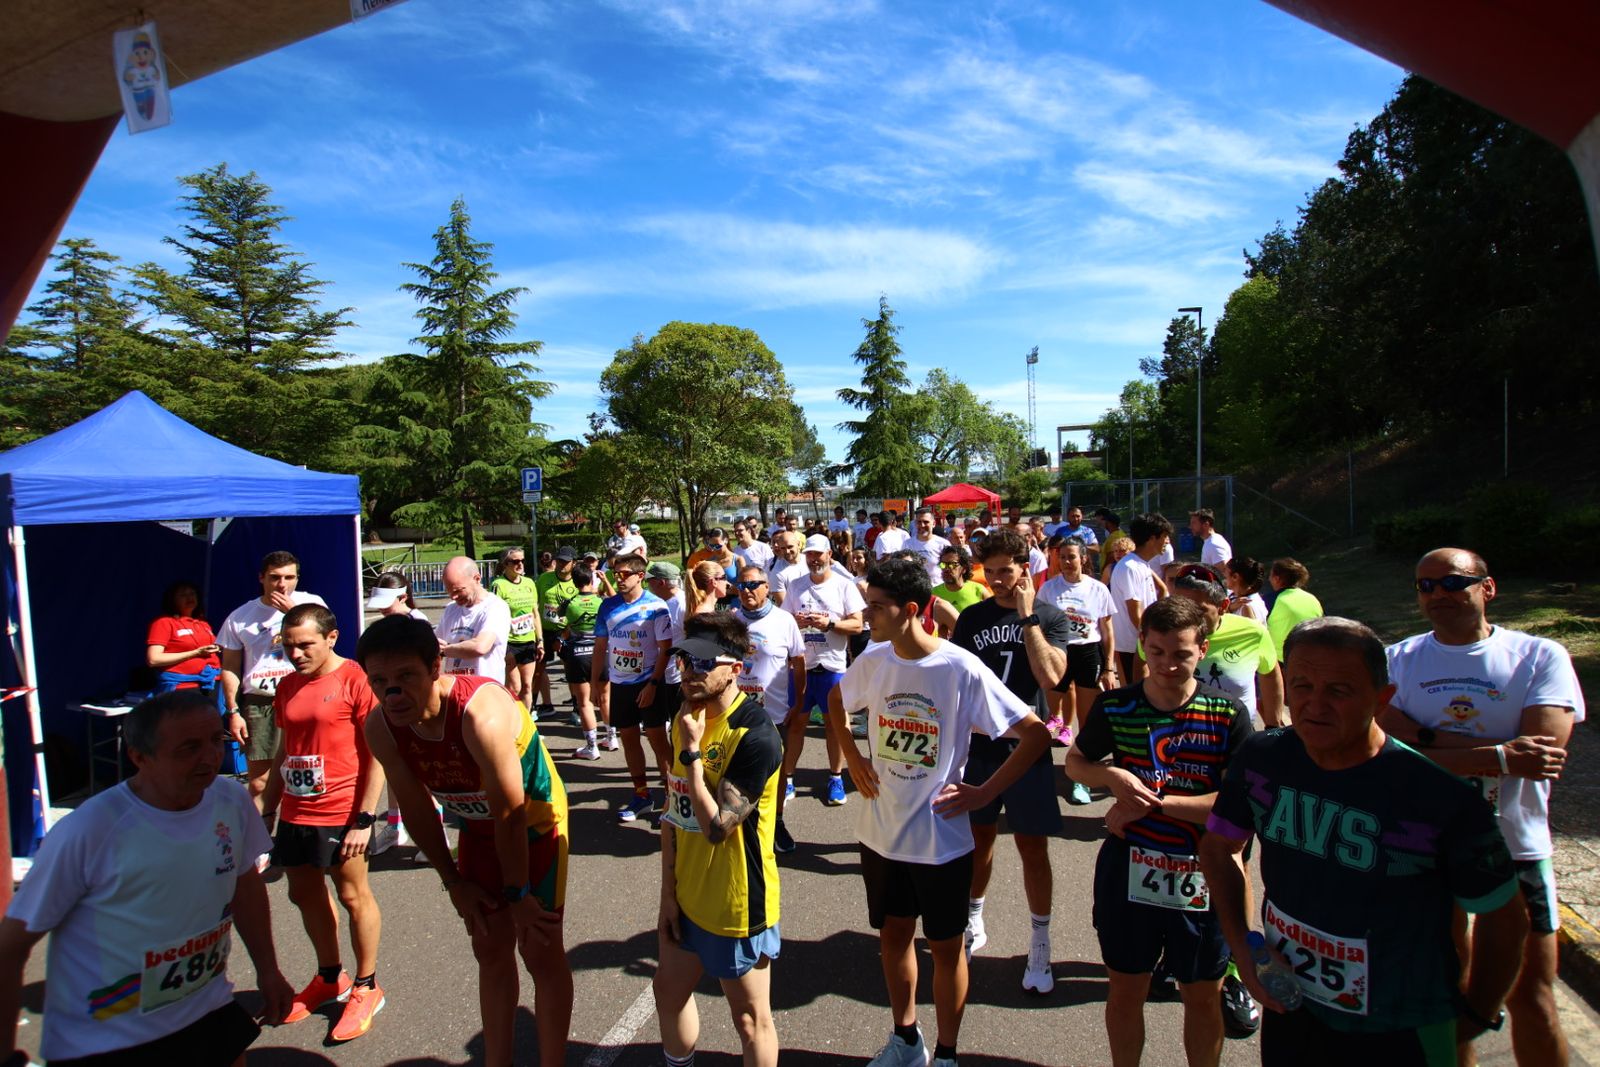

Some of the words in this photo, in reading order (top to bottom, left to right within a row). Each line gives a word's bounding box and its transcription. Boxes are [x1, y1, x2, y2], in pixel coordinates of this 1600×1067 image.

[525, 470, 538, 490] P
[973, 624, 1024, 651] BROOKL
[616, 656, 638, 668] 490
[1000, 651, 1013, 684] 7
[879, 715, 938, 736] bedunia
[886, 730, 929, 756] 472
[1263, 785, 1380, 872] AVS
[1142, 868, 1196, 897] 416
[1267, 905, 1364, 964] bedunia
